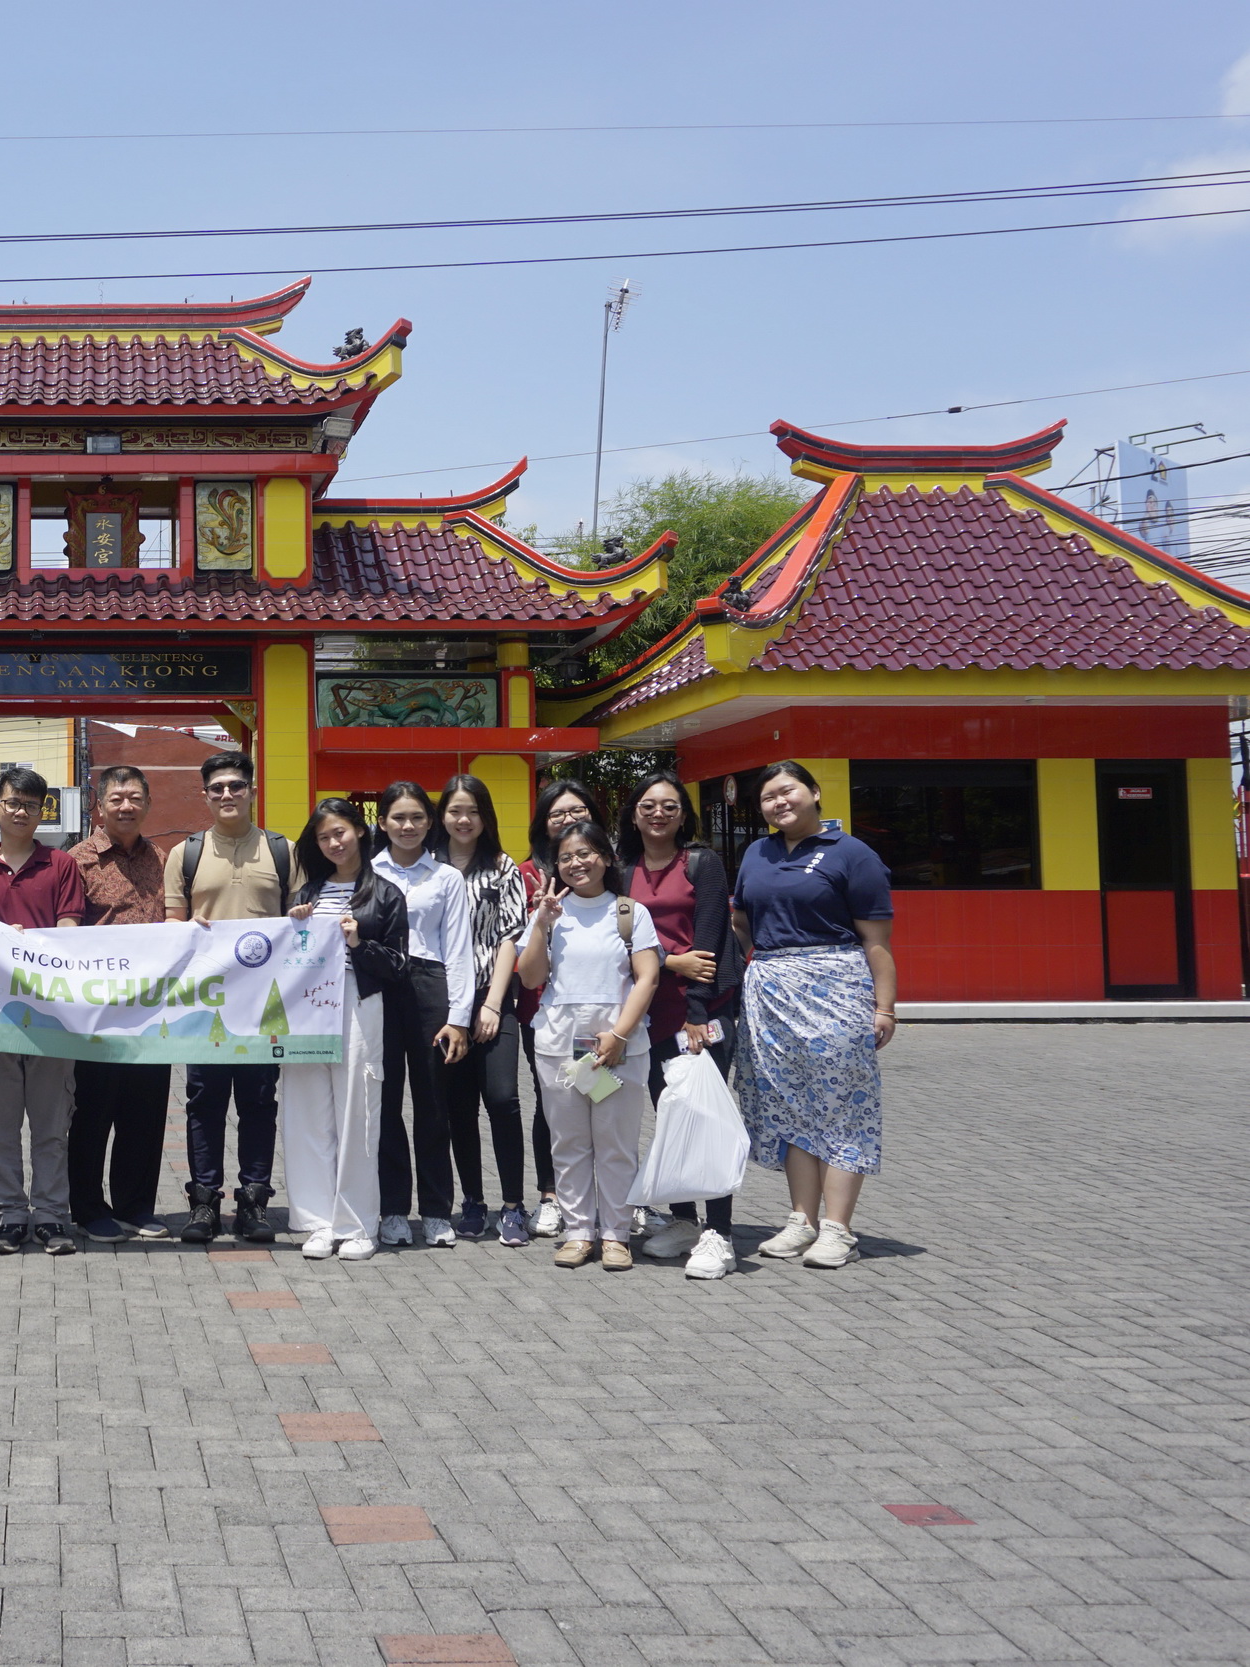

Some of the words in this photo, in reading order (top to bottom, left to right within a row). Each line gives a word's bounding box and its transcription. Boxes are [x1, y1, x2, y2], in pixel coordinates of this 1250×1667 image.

[11, 653, 83, 662] YAYASAN
[110, 653, 204, 662] KELENTENG
[68, 665, 107, 676] AN
[120, 665, 219, 677] KIONG
[57, 680, 157, 689] MALANG
[11, 947, 130, 971] ENCOUNTER
[9, 967, 75, 1003] MA
[81, 975, 226, 1008] CHUNG
